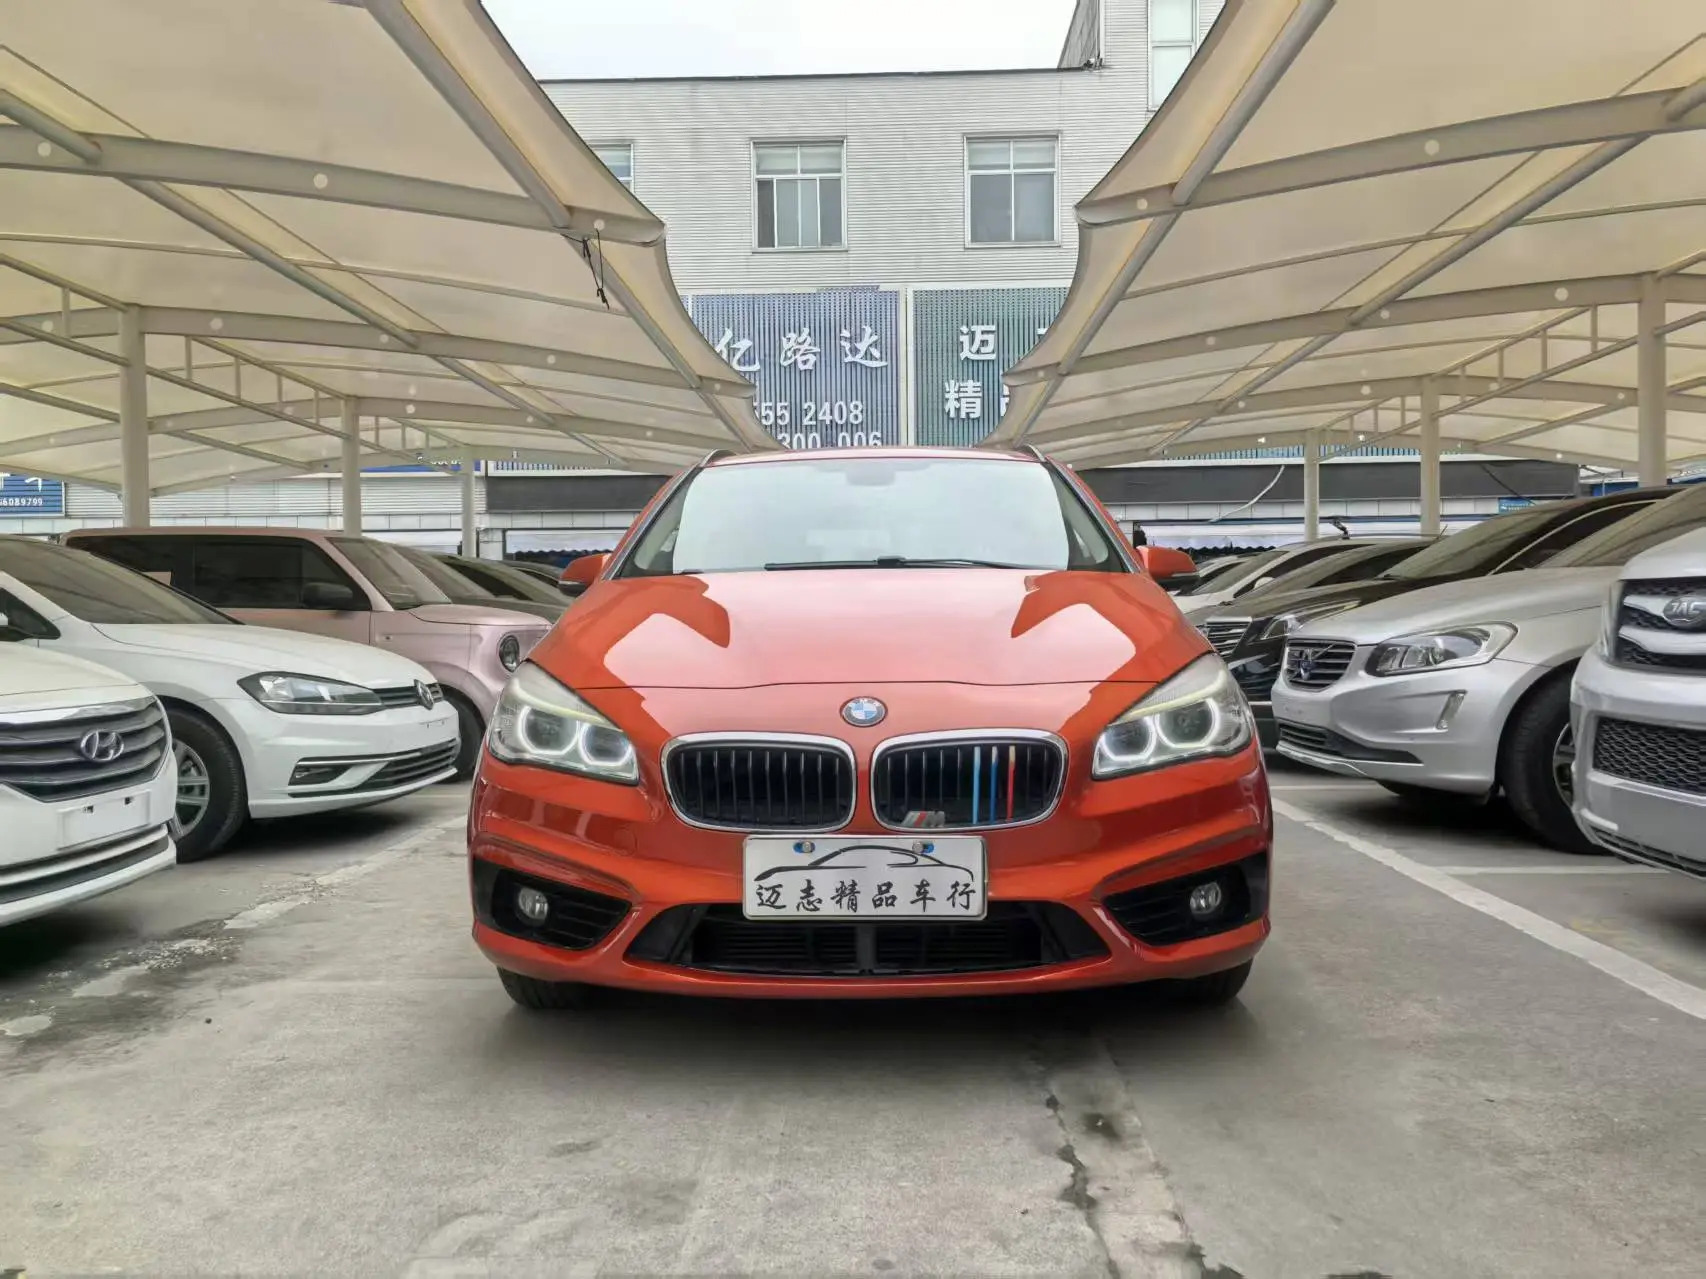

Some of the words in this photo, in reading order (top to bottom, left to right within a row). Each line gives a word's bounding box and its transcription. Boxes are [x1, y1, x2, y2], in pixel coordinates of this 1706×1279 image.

[715, 325, 889, 372] 亿路达
[753, 401, 790, 425] 55
[802, 401, 863, 425] 2408
[945, 380, 1010, 418] 精
[755, 879, 976, 912] 迈志精品车行
